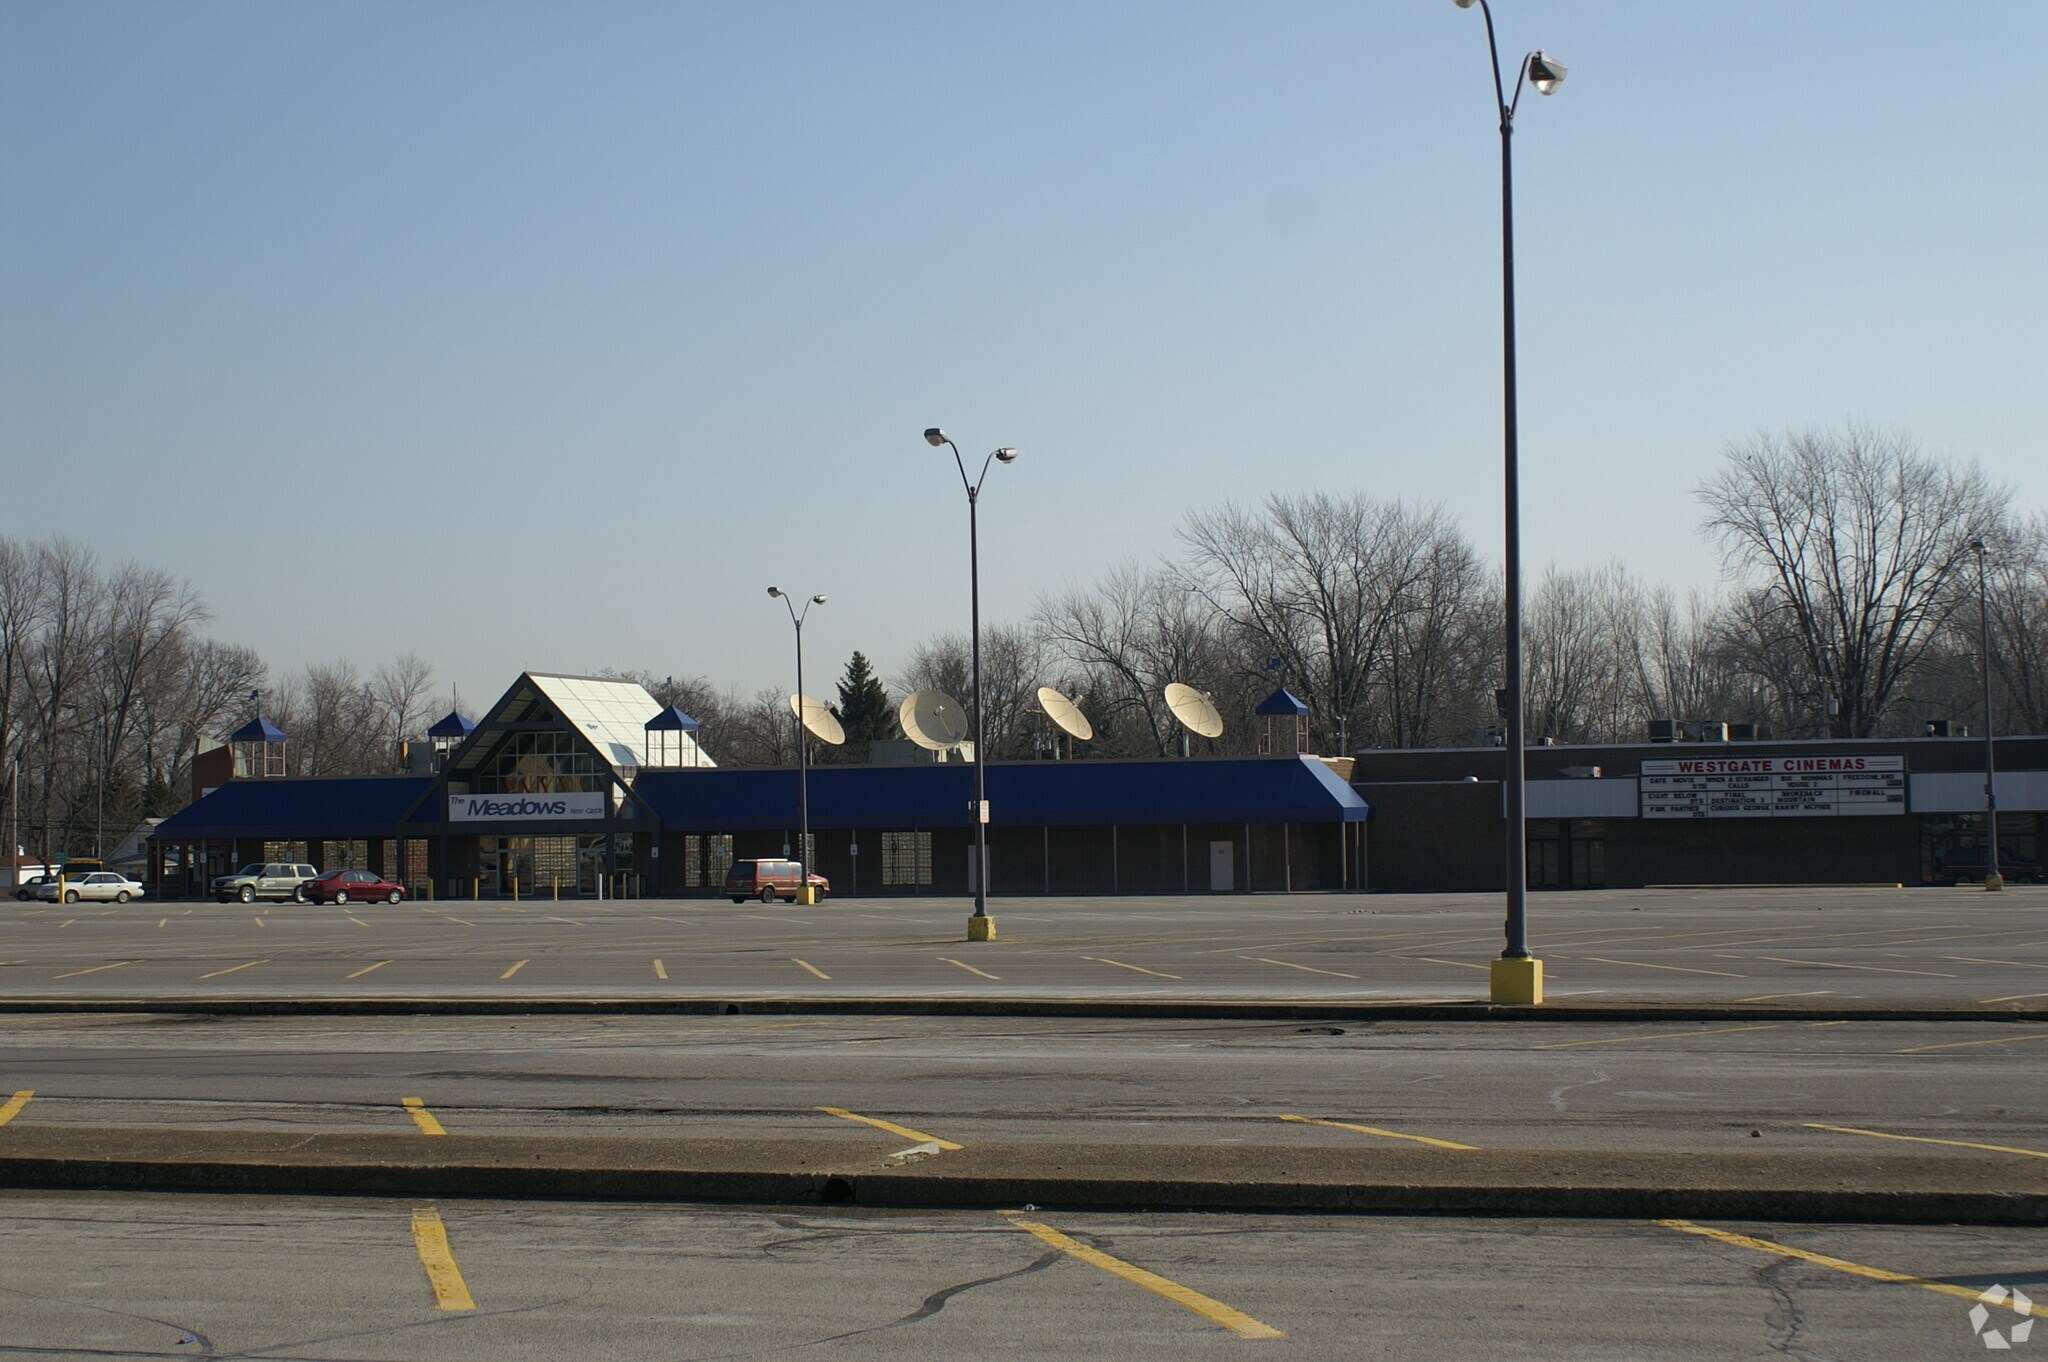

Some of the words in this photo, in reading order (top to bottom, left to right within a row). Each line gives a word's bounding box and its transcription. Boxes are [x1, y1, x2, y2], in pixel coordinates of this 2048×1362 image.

[1679, 761, 1773, 773] WESTGATE
[1783, 758, 1866, 771] CINEMAS
[450, 796, 465, 805] The
[467, 798, 566, 816] Meadows
